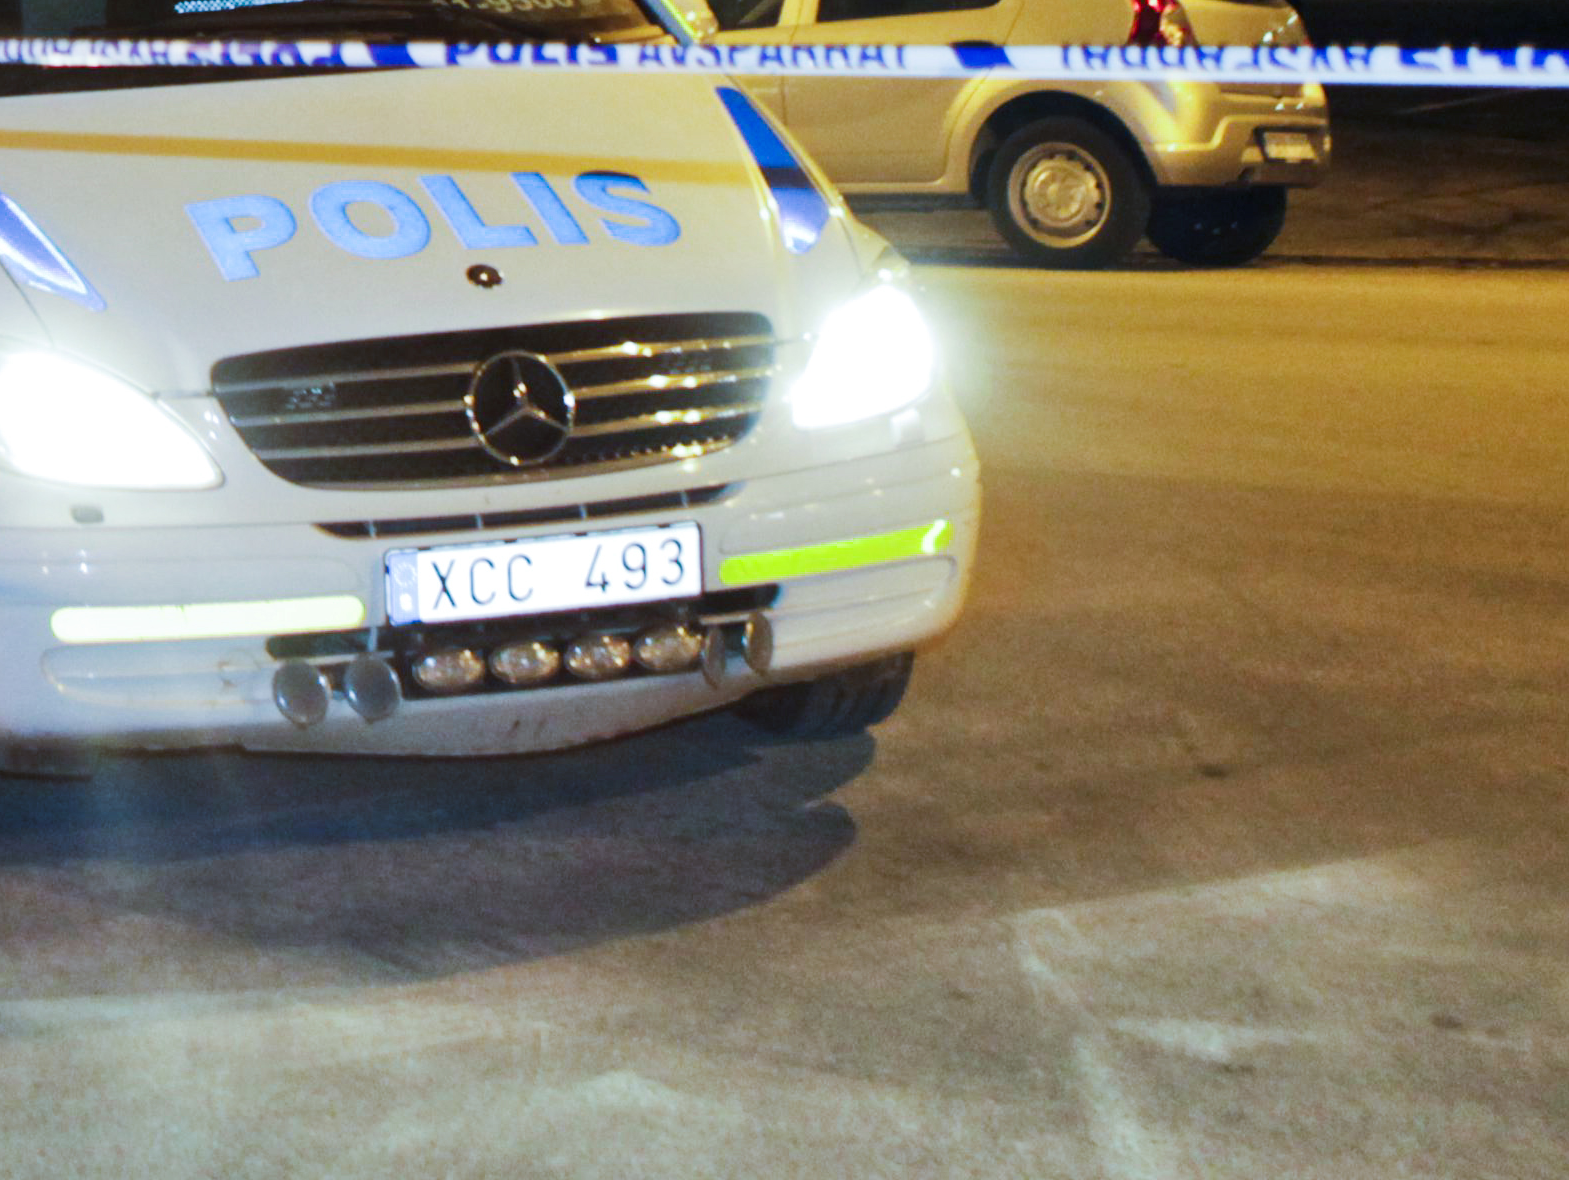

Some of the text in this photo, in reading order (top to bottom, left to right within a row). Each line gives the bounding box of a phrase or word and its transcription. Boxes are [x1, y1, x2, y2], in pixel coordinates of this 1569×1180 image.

[183, 170, 682, 282] POLIS
[432, 539, 685, 610] XCC 493
